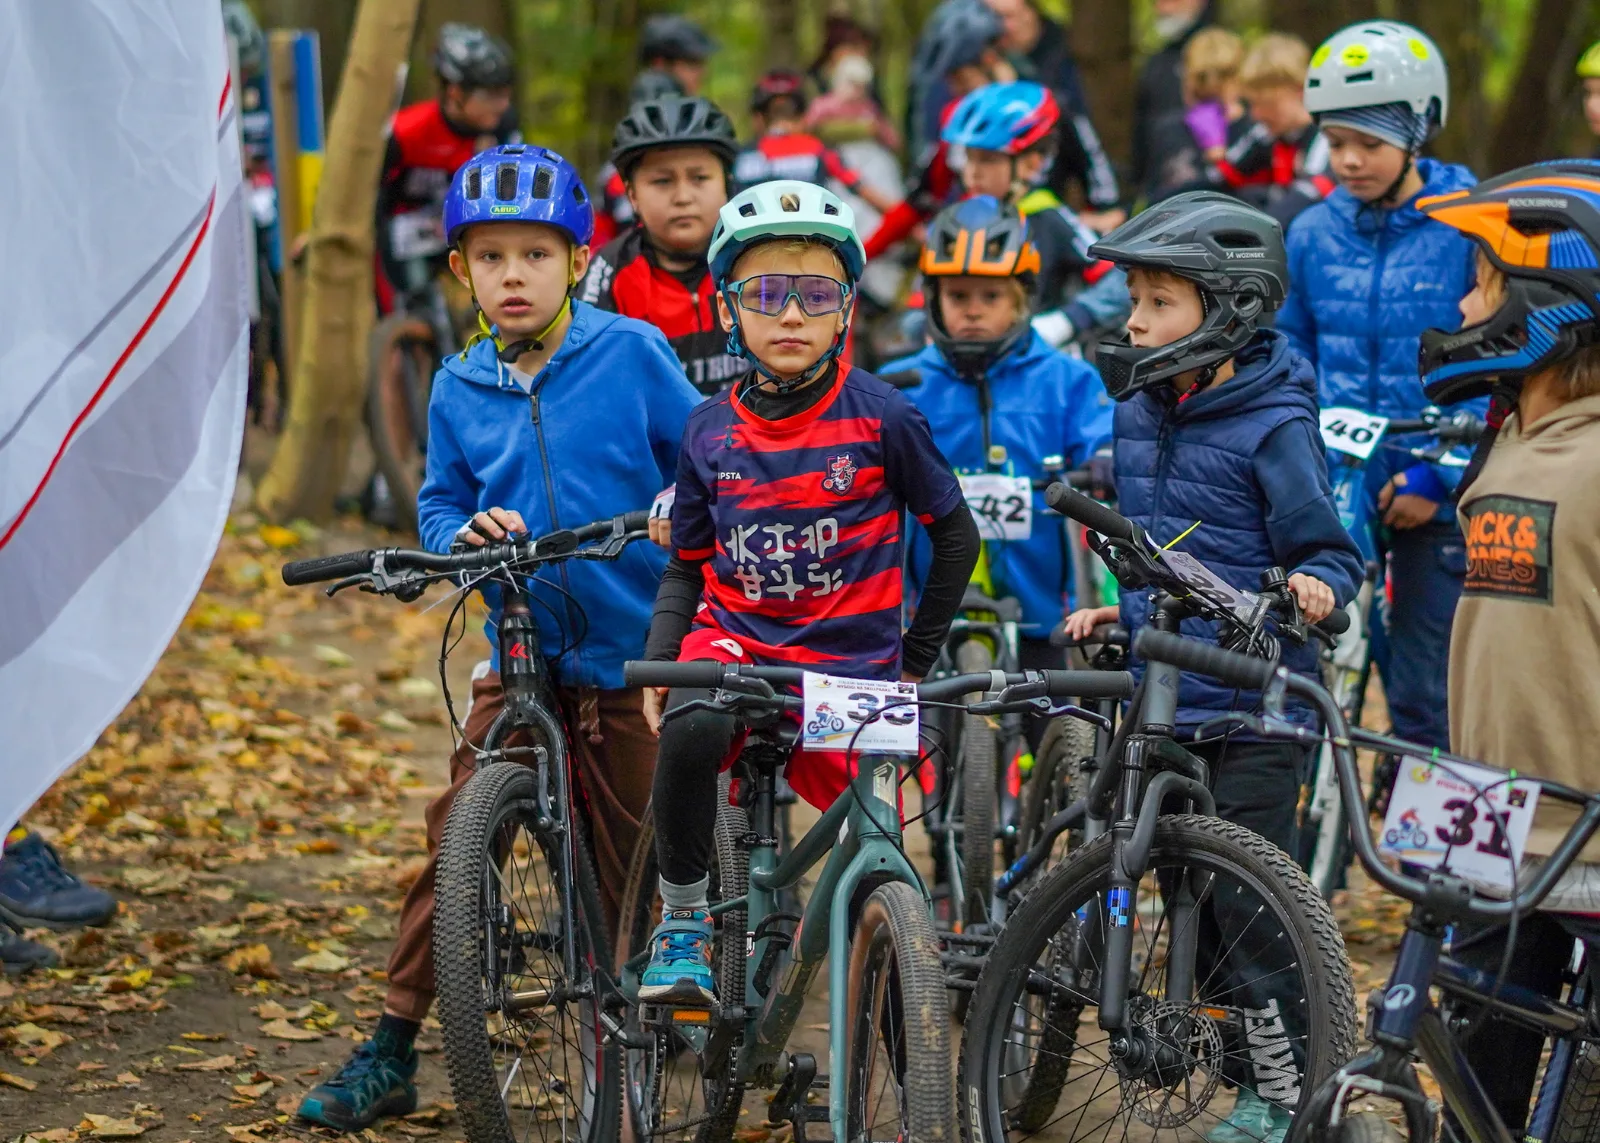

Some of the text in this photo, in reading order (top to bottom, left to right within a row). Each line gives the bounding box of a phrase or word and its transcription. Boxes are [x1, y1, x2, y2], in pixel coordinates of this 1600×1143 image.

[1325, 419, 1374, 444] 40
[981, 494, 1025, 522] 42
[846, 692, 917, 727] 35
[1434, 797, 1511, 859] 31
